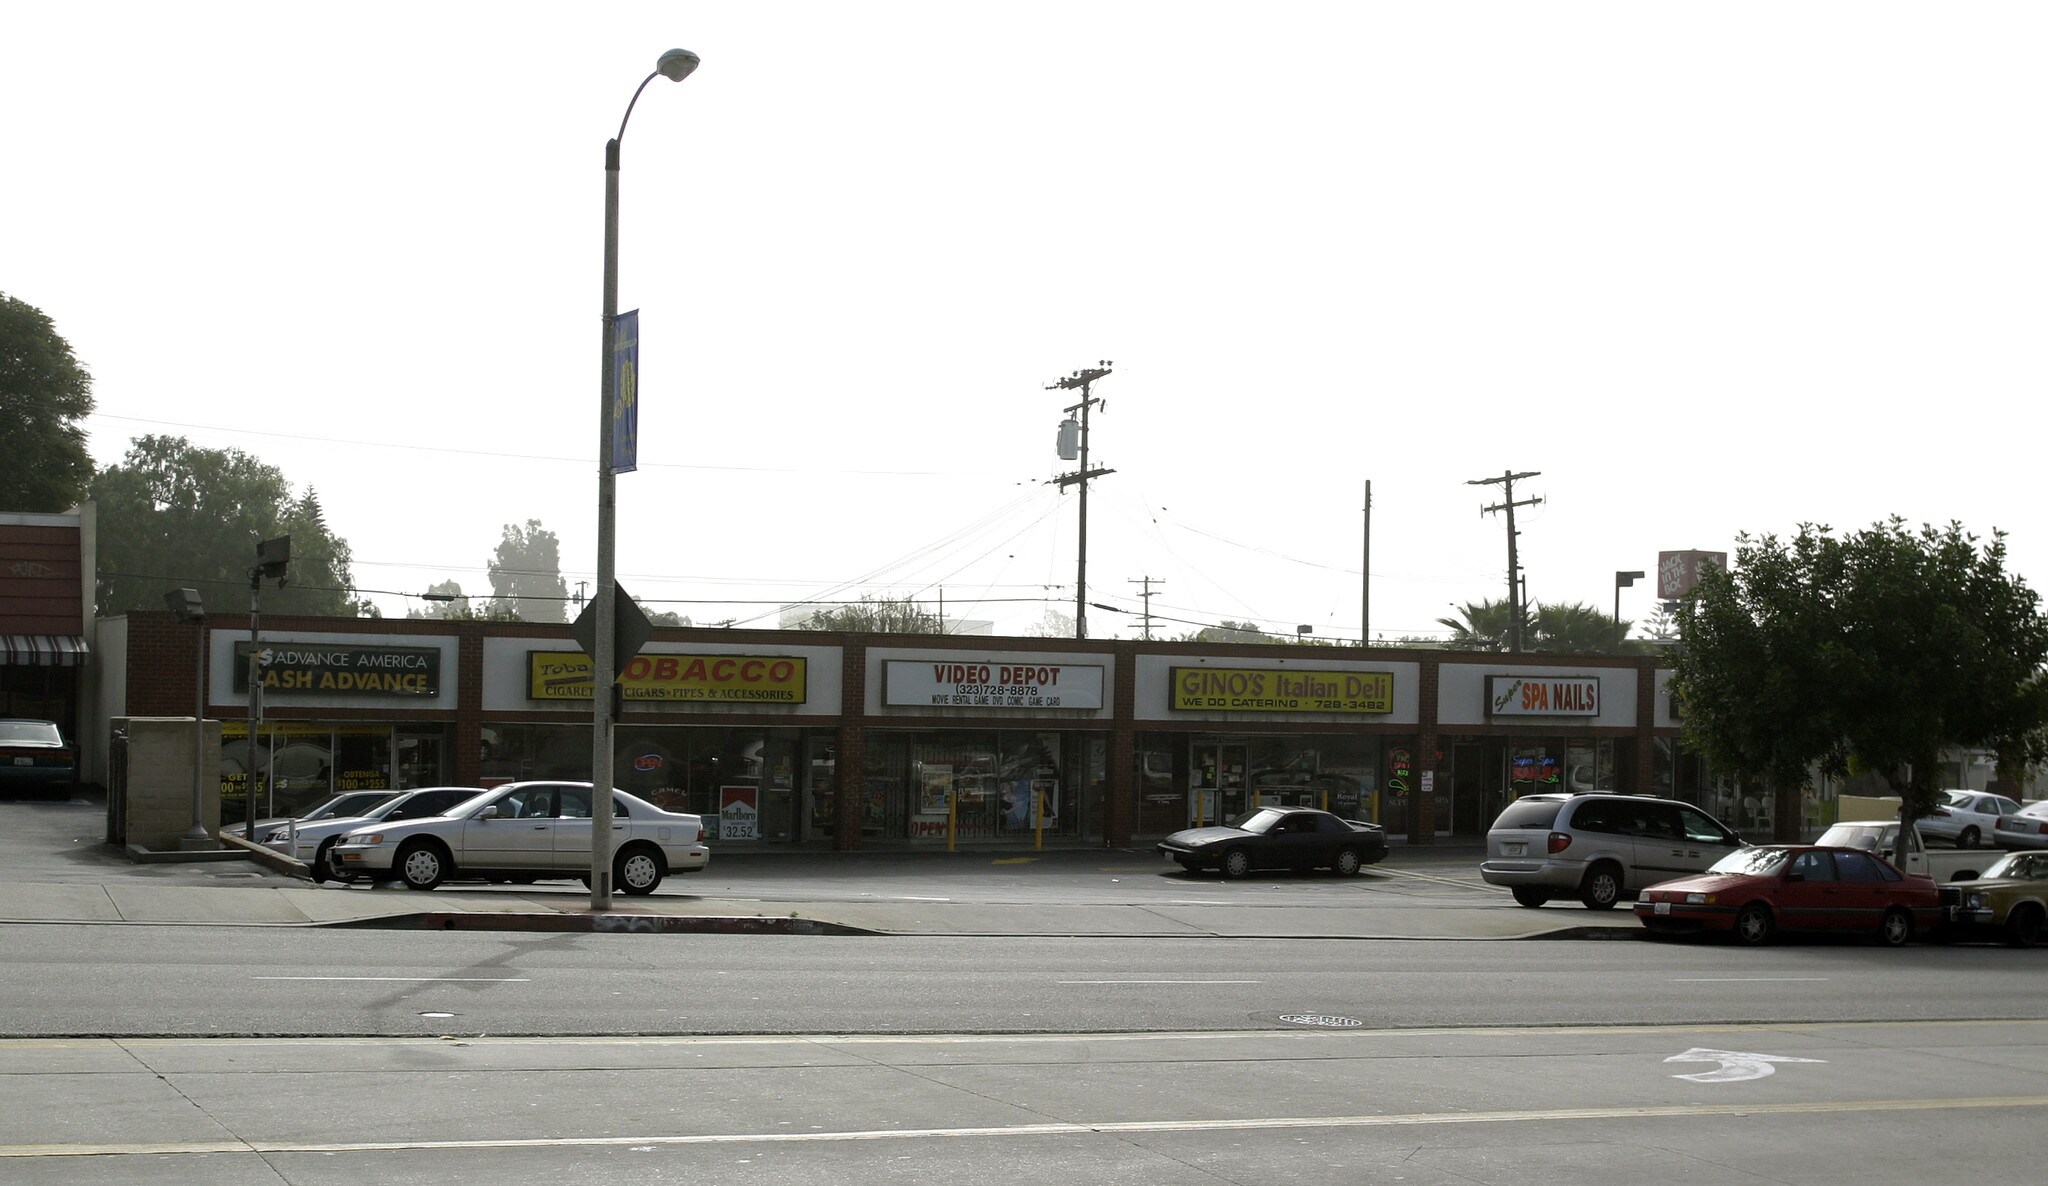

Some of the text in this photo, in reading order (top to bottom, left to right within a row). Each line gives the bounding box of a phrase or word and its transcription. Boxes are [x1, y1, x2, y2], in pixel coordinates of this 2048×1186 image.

[1660, 553, 1682, 573] JACK
[1664, 578, 1682, 595] BOX
[274, 651, 427, 668] ADVANCE AMERICA
[541, 663, 590, 676] Toba
[623, 657, 794, 682] OBACCO
[934, 664, 1060, 686] VIDEO DEPOT
[257, 669, 428, 691] ASH ADVANCE
[1182, 672, 1385, 699] GINO'S Italian Deli
[545, 685, 794, 700] CIGARET CIGARS PIPES & ACCESSORIES
[956, 684, 1038, 696] (323)728-8878
[1522, 682, 1595, 711] SPA NAILS
[932, 695, 949, 705] MOVIE
[952, 695, 971, 705] RENTAL
[974, 696, 988, 705] GAME
[993, 696, 1003, 706] DVD
[1029, 696, 1043, 706] GAME
[1046, 697, 1060, 706] CARD
[1183, 697, 1202, 706] WE
[1208, 698, 1226, 706] DO
[1231, 698, 1298, 708] CATERING
[228, 773, 248, 781] GET
[722, 808, 756, 820] Marlboro
